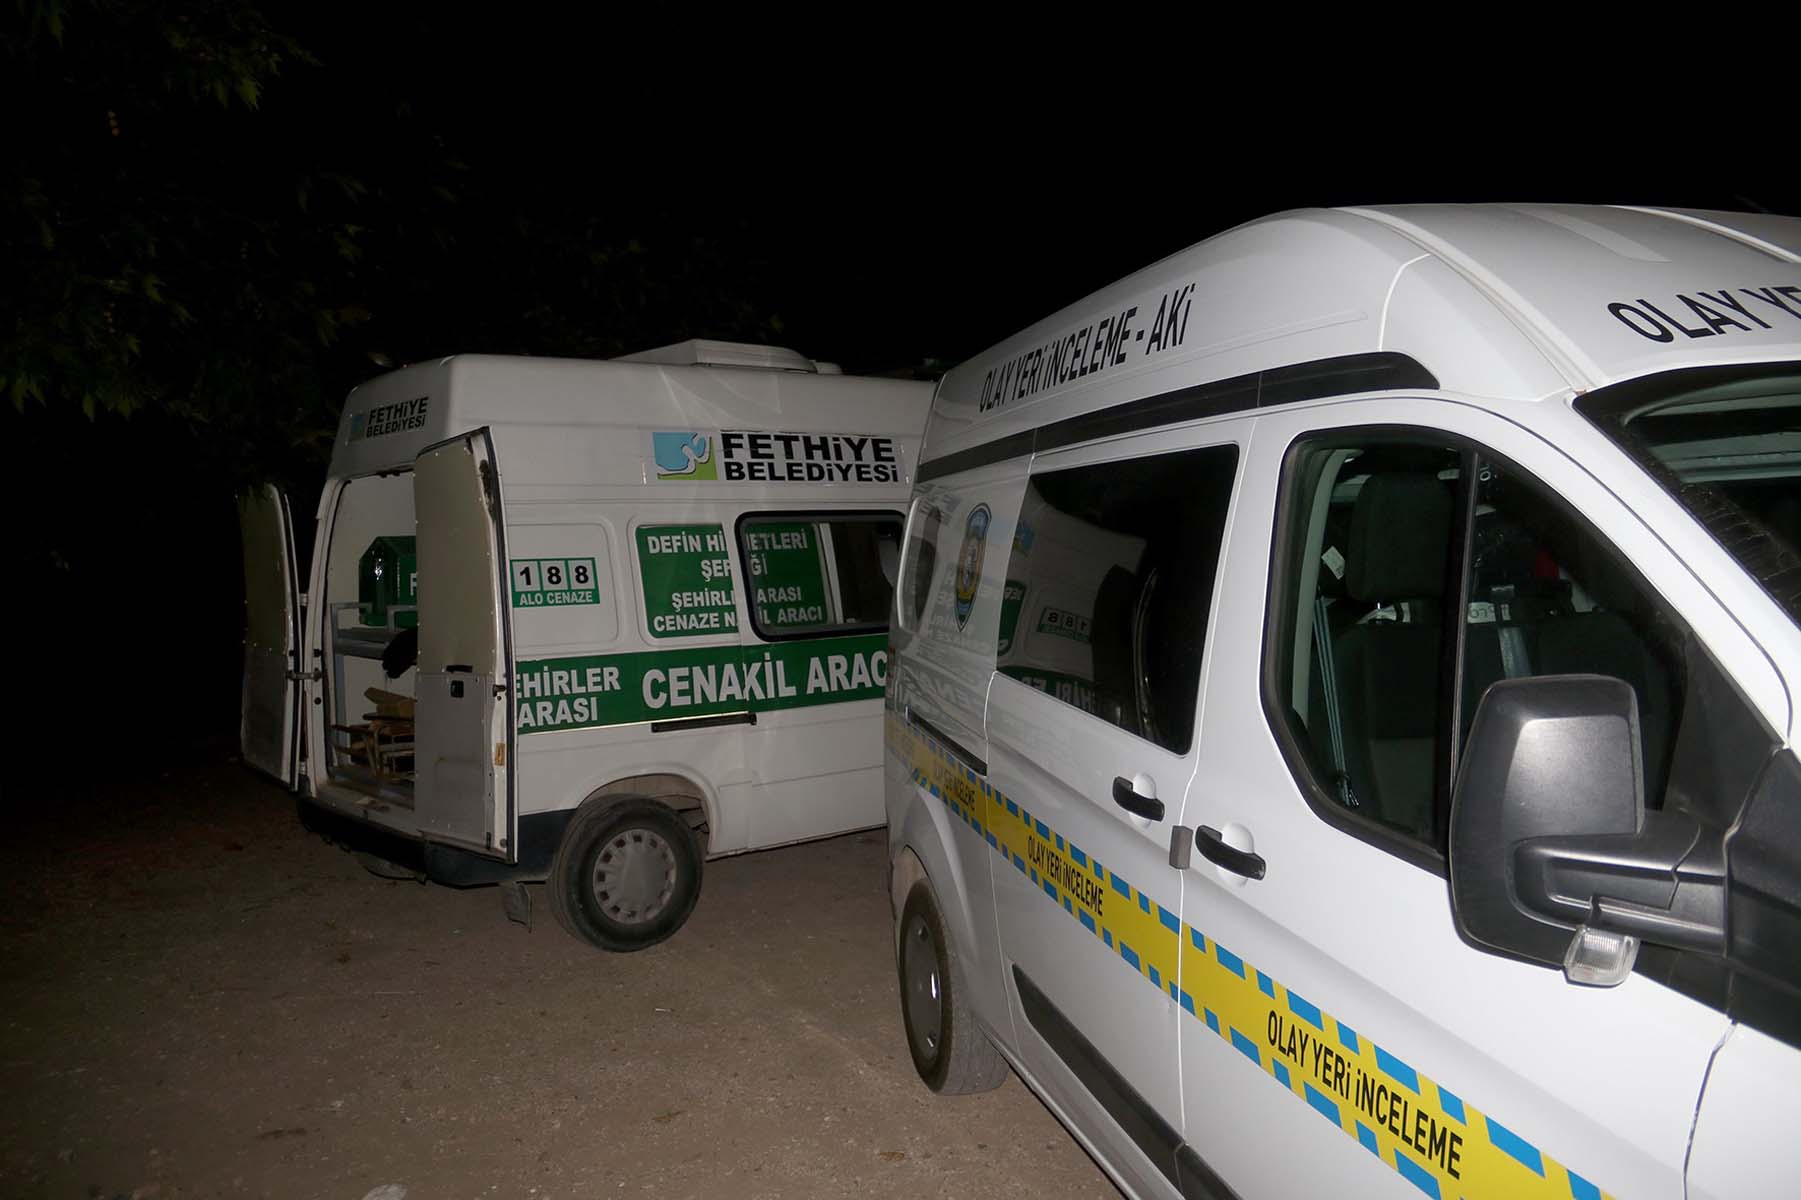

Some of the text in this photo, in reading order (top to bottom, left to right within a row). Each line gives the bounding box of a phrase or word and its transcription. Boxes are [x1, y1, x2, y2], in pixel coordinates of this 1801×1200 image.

[1607, 290, 1773, 343] OLAY
[979, 359, 1017, 413] OLAY
[647, 531, 702, 554] DEFİN
[519, 591, 593, 606] ALO CENAZE
[756, 586, 802, 603] ARASI
[653, 612, 721, 632] CENAZE
[777, 605, 823, 624] ARACI
[642, 652, 797, 709] CENAKİL
[517, 696, 598, 729] ARASI
[1027, 835, 1047, 870] OLAY
[1268, 1010, 1309, 1068] OLAY
